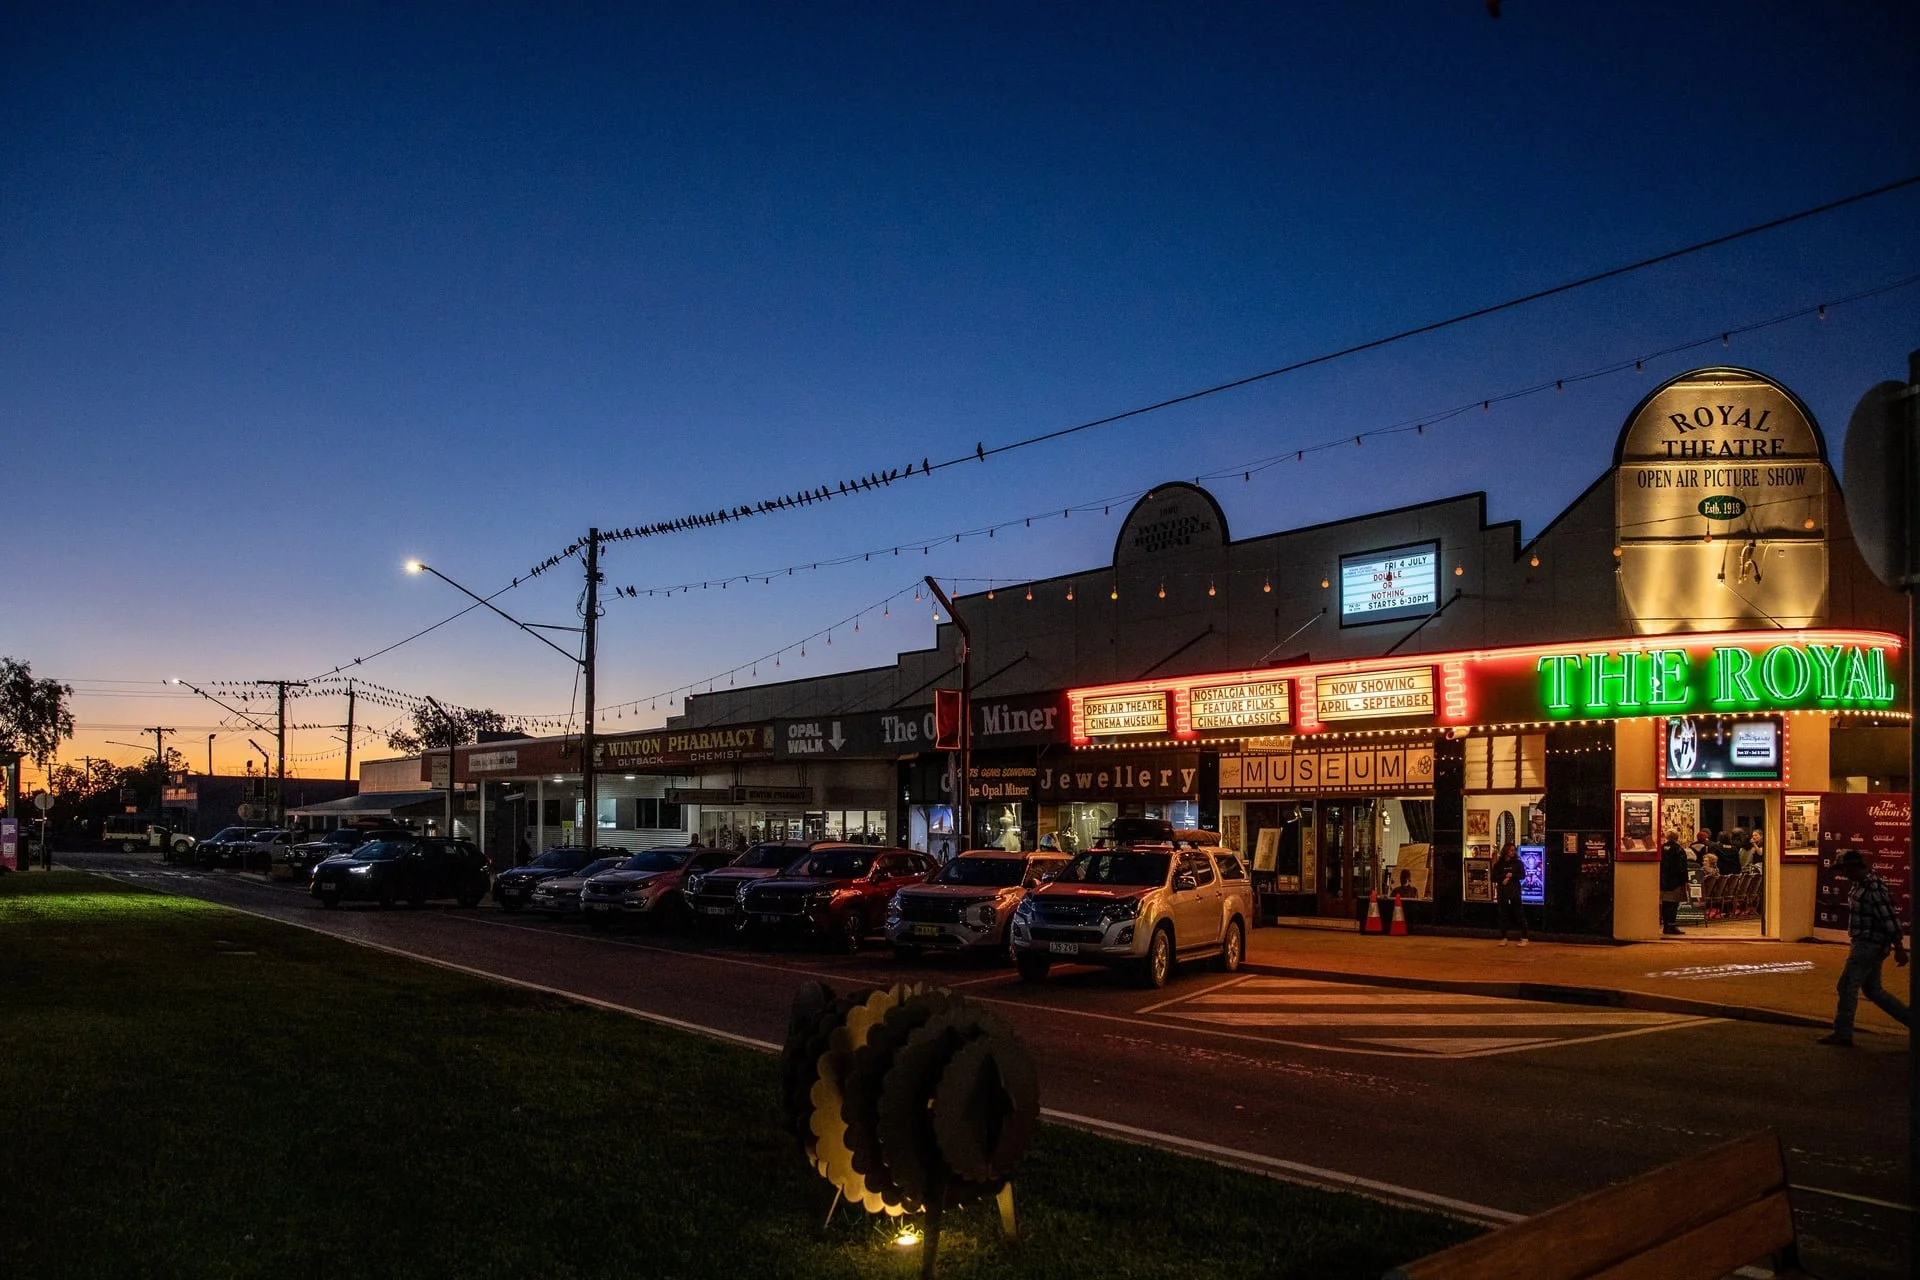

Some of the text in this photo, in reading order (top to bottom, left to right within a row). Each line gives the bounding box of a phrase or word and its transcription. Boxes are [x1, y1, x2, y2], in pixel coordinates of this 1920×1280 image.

[1668, 405, 1771, 434] ROYAL
[1661, 438, 1785, 458] THEATRE
[1637, 467, 1807, 488] OPEN AIR PICTURE SHOW
[1723, 502, 1741, 515] 1918
[1146, 535, 1191, 553] OPAL
[1384, 562, 1397, 571] FRI
[1399, 560, 1405, 568] 4
[1407, 556, 1427, 567] JULY
[1373, 570, 1402, 582] DOULE
[1382, 581, 1393, 590] OR
[1371, 589, 1405, 601] NOTHING
[1368, 599, 1397, 610] STARTS
[1536, 643, 1895, 710] THE ROYAL
[1194, 682, 1284, 702] NOSTALGIA NIGHTS
[1331, 677, 1415, 695] NOW SHOWING
[1086, 699, 1163, 716] OPEN AIR THEATRE
[1203, 697, 1275, 714] FEATURE FILMS
[1320, 700, 1351, 712] APRIL
[1362, 693, 1429, 710] SEPTEMBER
[881, 715, 918, 744] The
[982, 703, 1057, 736] Miner
[1090, 714, 1159, 730] CINEMA MUSEUM
[1197, 711, 1281, 728] CINEMA CLASSICS
[788, 722, 823, 738] OPAL
[608, 728, 757, 757] WINTON PHARMACY
[787, 739, 825, 754] WALK
[618, 756, 664, 767] OUTBACK
[690, 750, 742, 761] CHEMIST
[1001, 767, 1037, 777] SOUVENIRS
[1246, 754, 1400, 782] MUSEUM
[1041, 765, 1197, 794] Jewellery
[982, 784, 1004, 799] Opal
[1004, 783, 1030, 796] Miner
[1867, 806, 1900, 819] Vision
[1880, 800, 1898, 810] The
